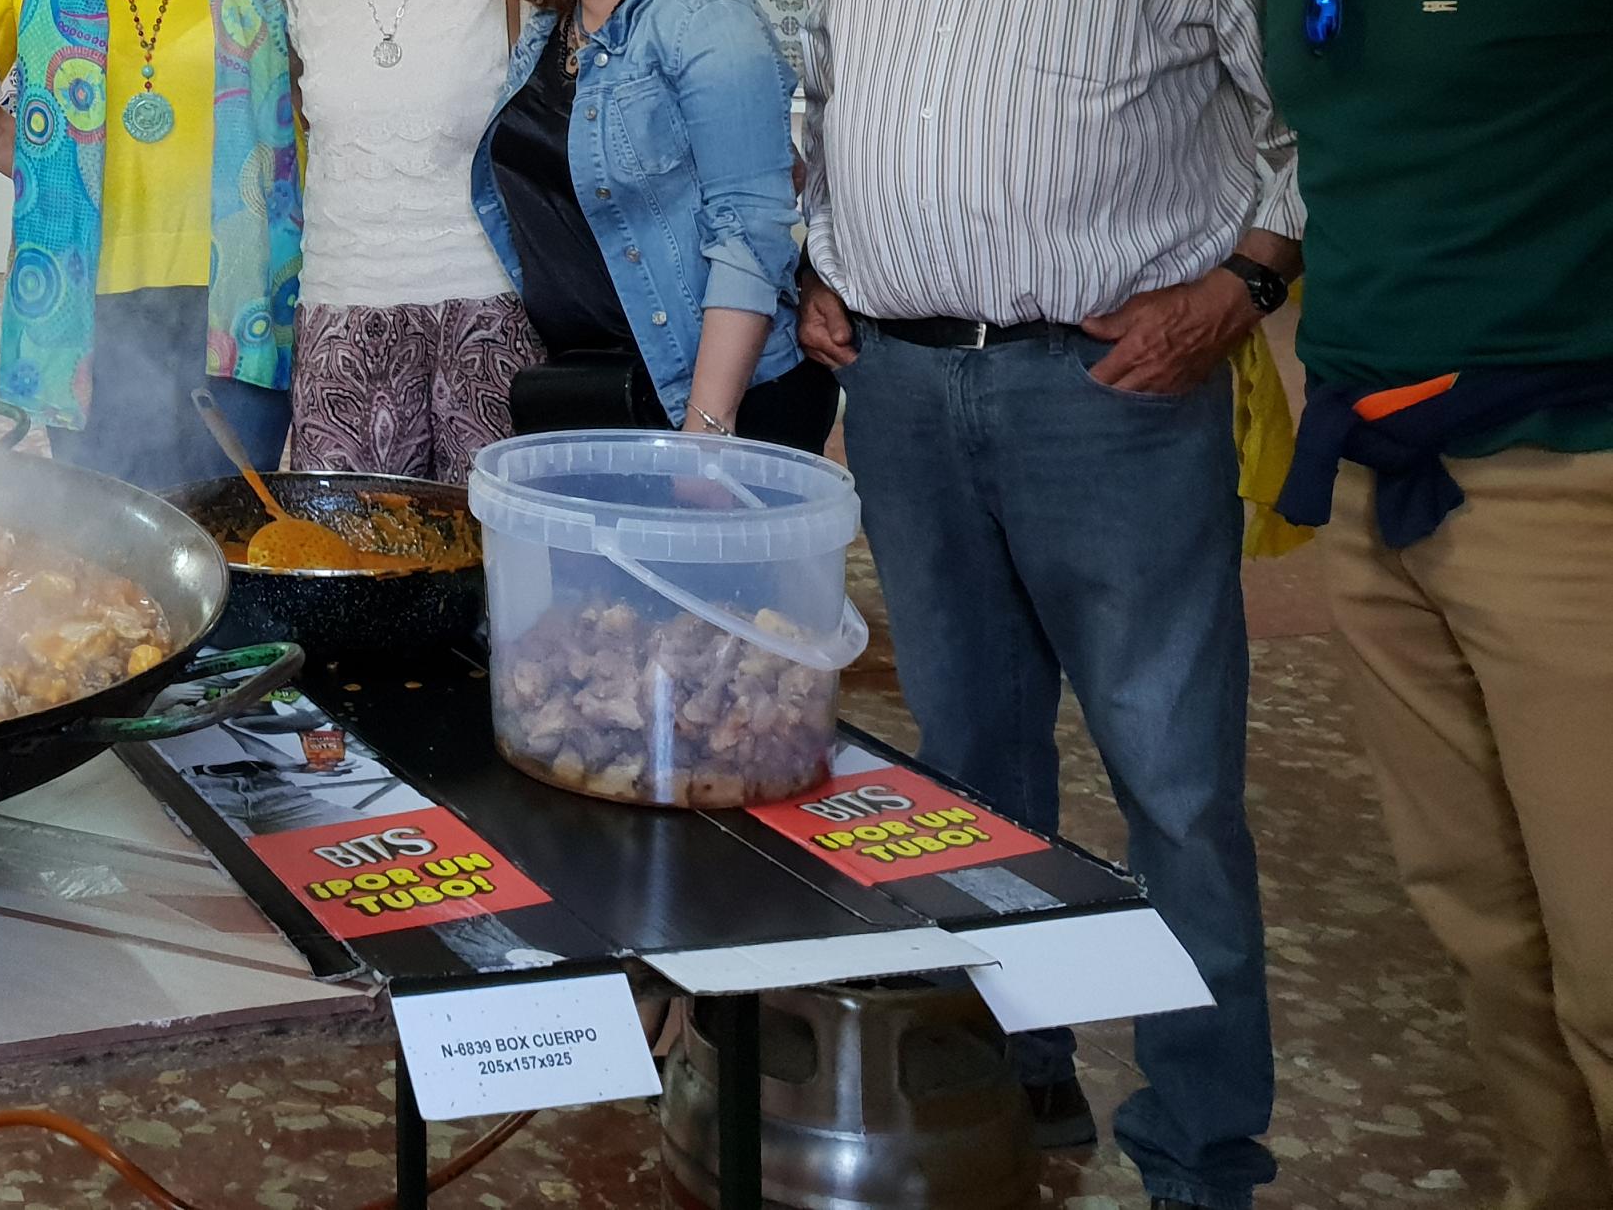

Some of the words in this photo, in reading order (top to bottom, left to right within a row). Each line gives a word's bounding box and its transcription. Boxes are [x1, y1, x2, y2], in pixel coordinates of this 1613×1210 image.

[800, 785, 915, 822] BITS
[313, 827, 436, 868] BITS
[814, 820, 917, 850] ¡POR
[912, 806, 978, 829] UN
[860, 825, 990, 862] TUBO!
[309, 867, 421, 899] ¡POR
[421, 852, 494, 878] UN
[350, 874, 496, 915] TUBO!
[441, 1039, 492, 1058] N-6839
[496, 1035, 530, 1052] BOX
[532, 1028, 597, 1048] CUERPO
[478, 1051, 573, 1075] 205x157x925
